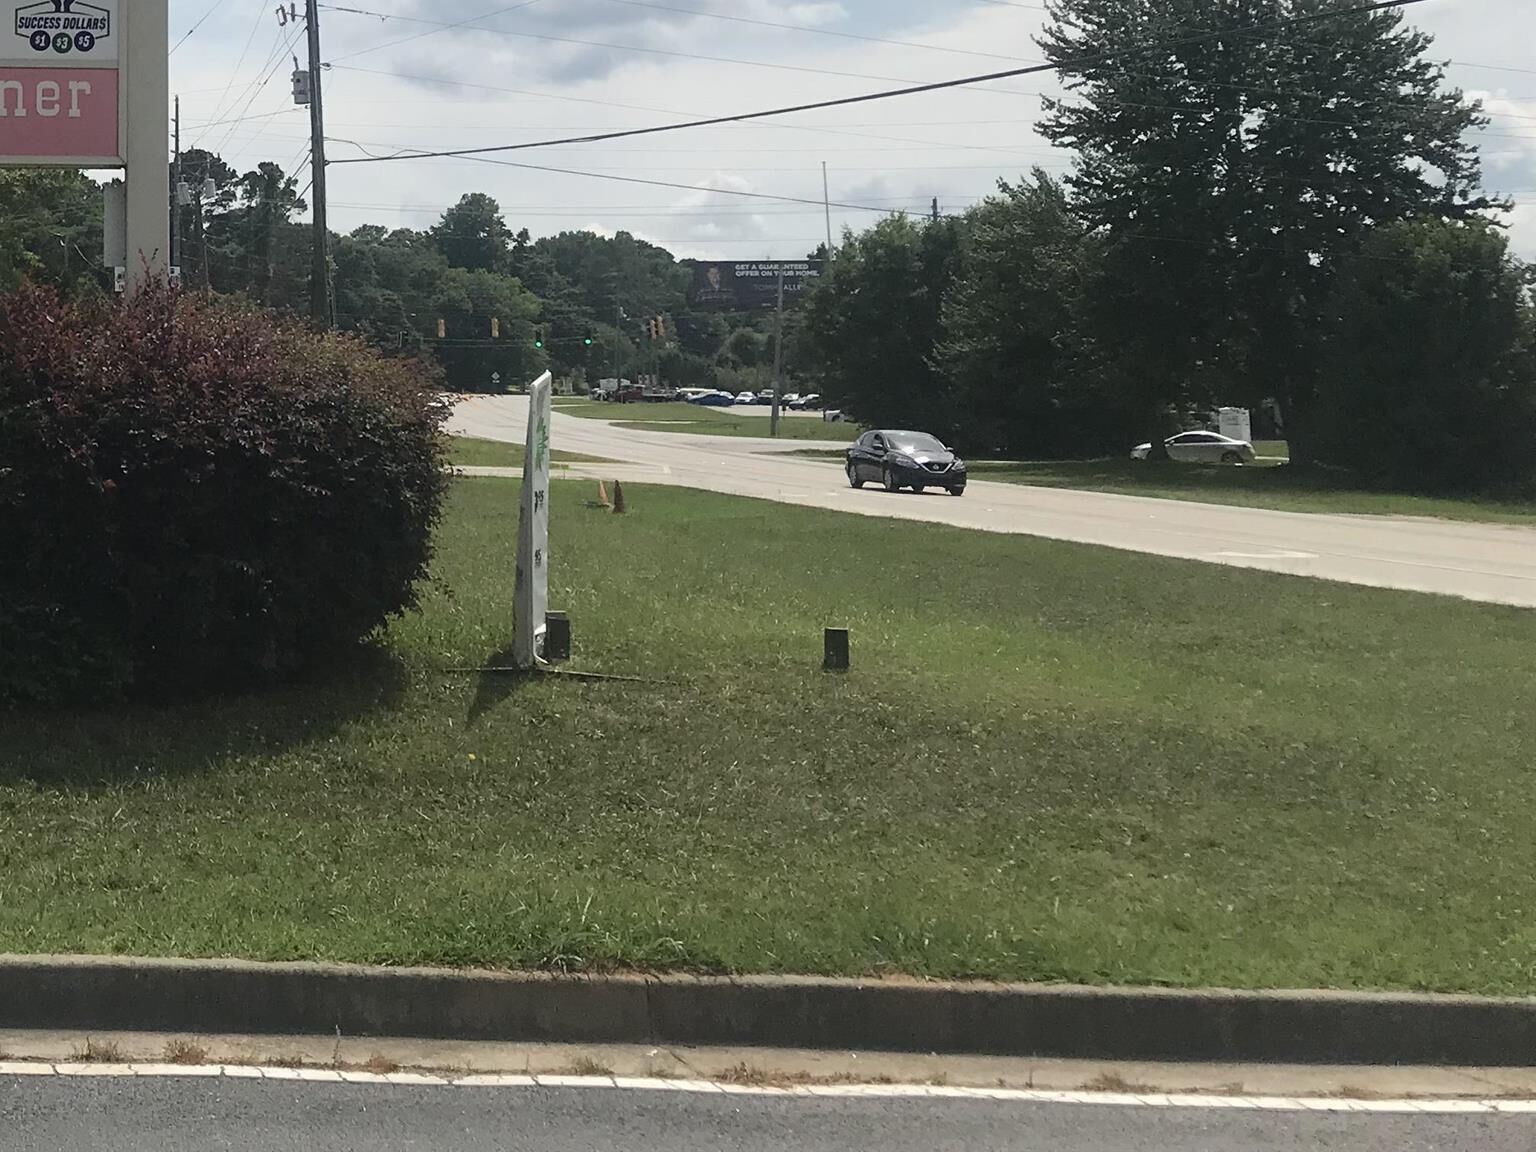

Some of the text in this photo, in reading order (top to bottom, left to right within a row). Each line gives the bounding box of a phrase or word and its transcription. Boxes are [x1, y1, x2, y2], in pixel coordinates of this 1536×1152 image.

[18, 16, 107, 32] SUCCESS DOLLAR$
[35, 35, 90, 49] $1 $3 $5
